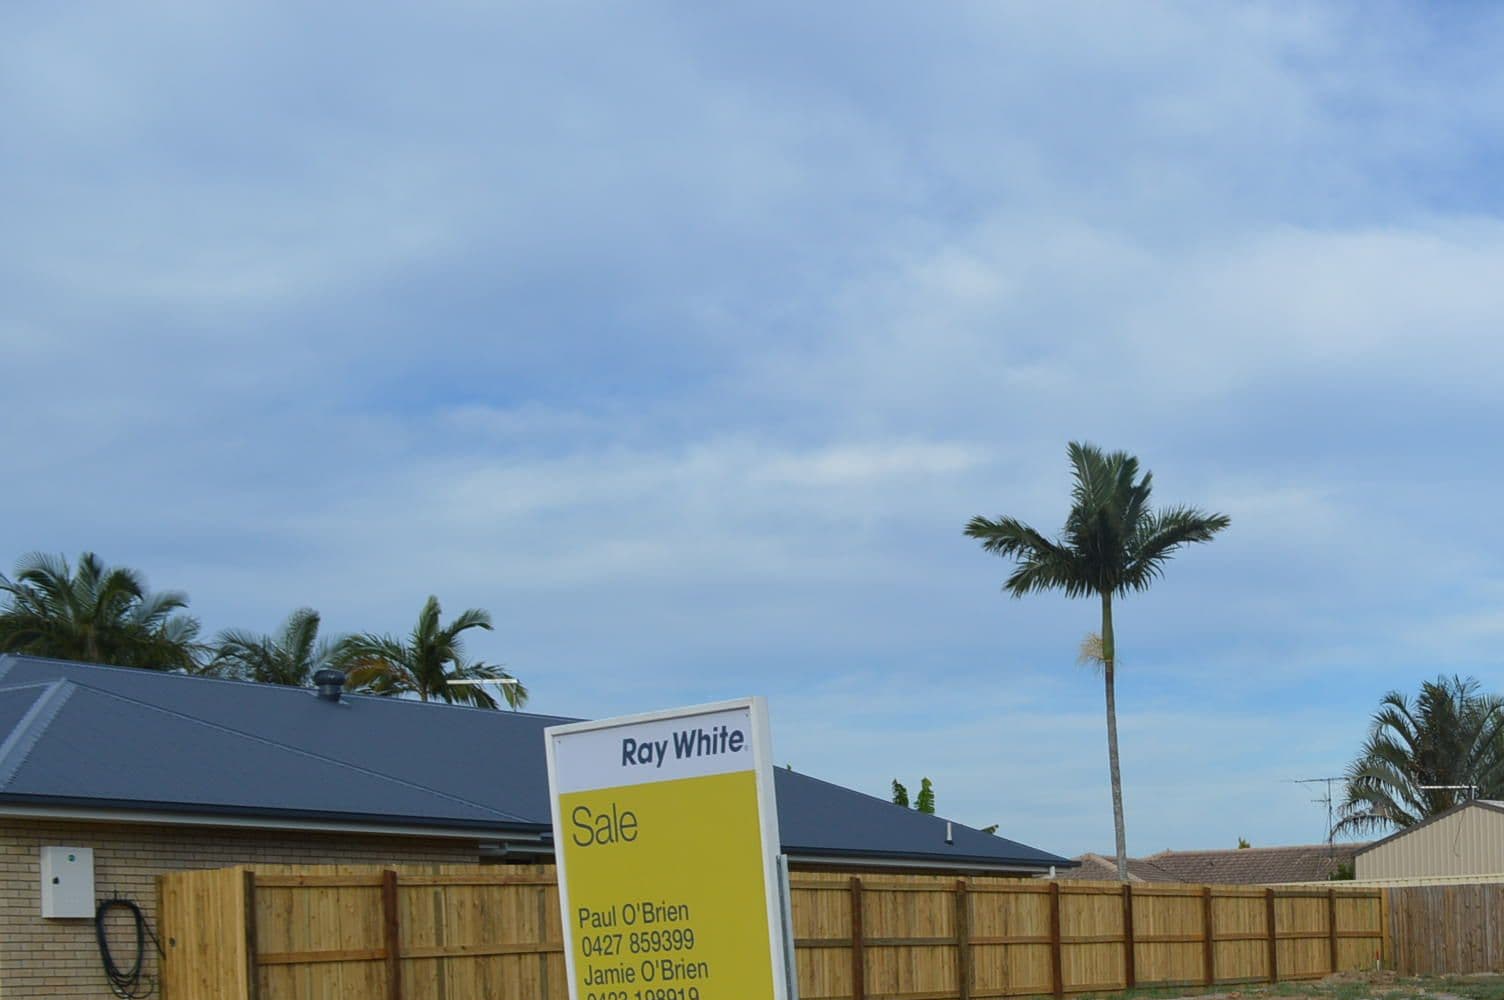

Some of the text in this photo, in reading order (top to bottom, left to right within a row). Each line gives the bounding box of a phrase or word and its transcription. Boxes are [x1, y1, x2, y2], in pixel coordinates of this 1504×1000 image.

[621, 725, 745, 769] Ray White
[571, 803, 638, 847] Sale
[578, 901, 690, 929] Paul O'Brien
[581, 928, 695, 957] 0427 859399
[584, 957, 710, 986] Jamie O'Brien
